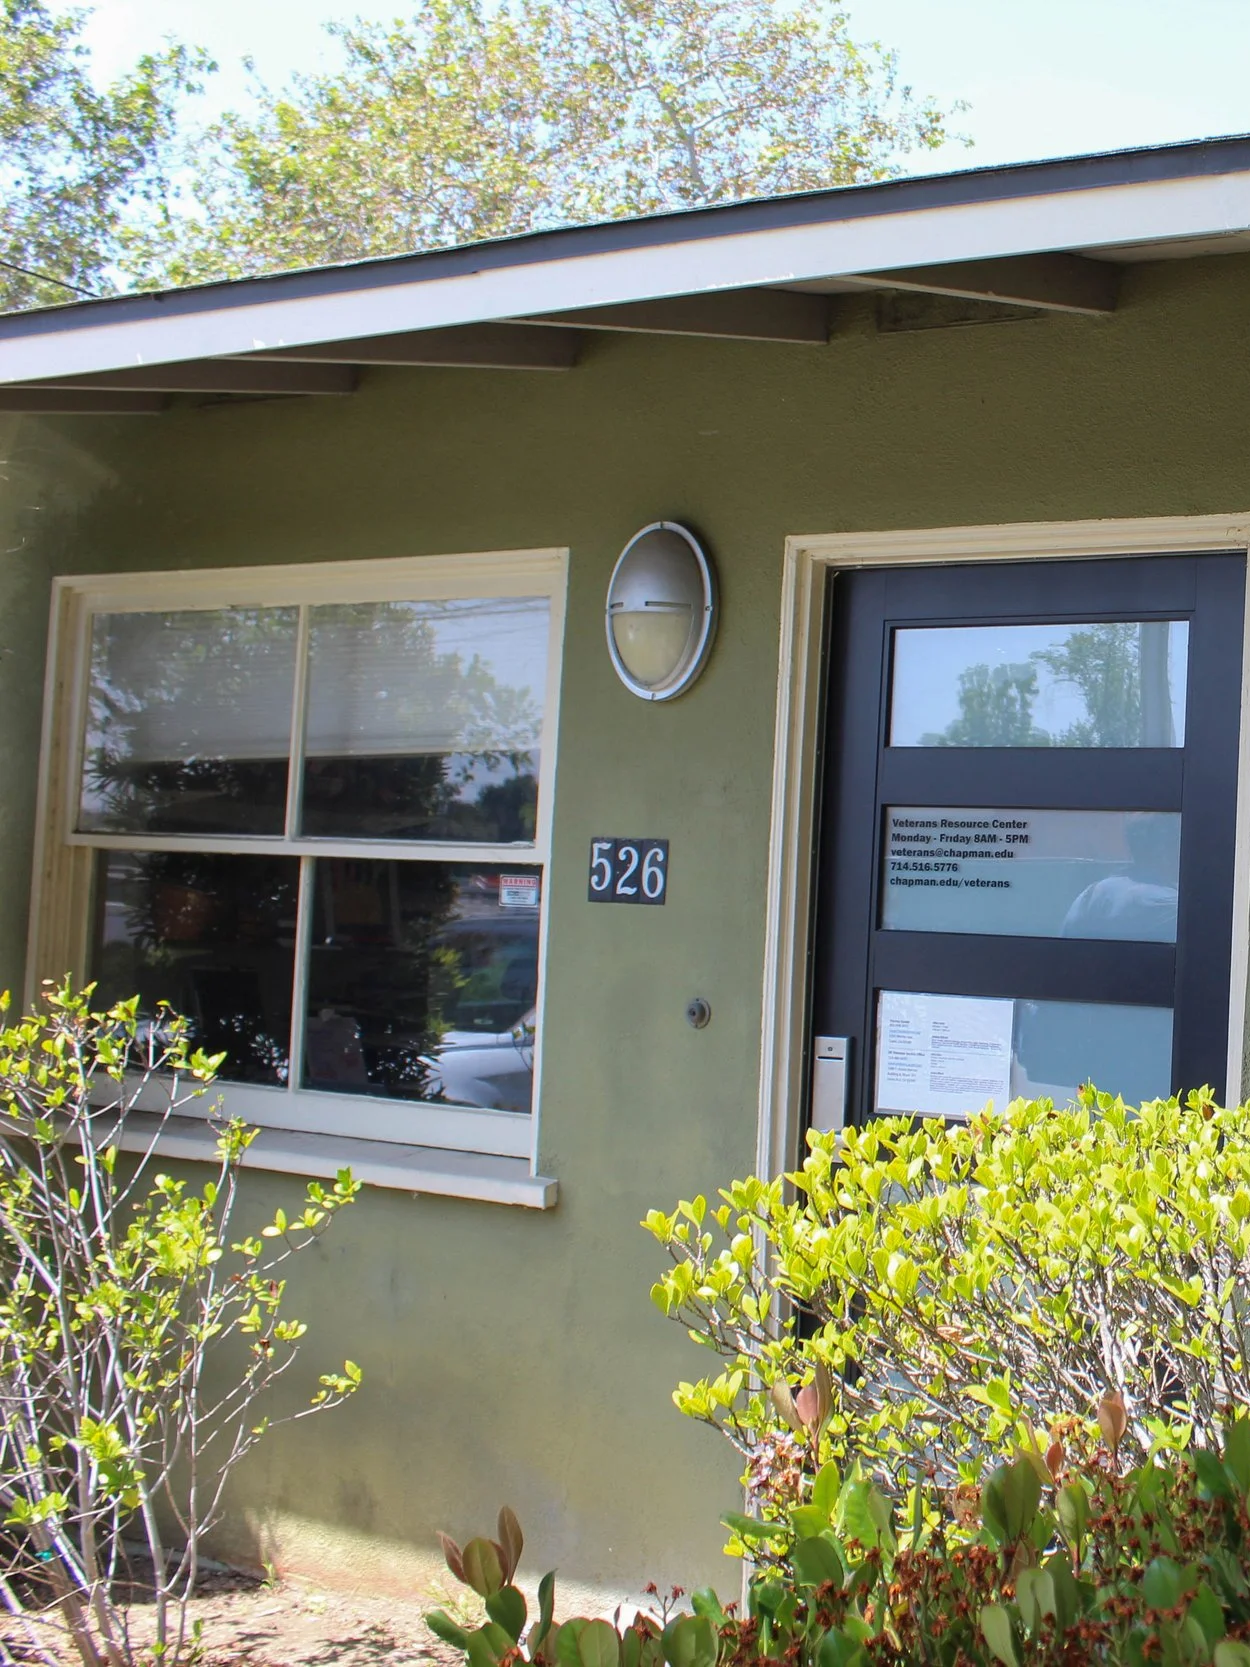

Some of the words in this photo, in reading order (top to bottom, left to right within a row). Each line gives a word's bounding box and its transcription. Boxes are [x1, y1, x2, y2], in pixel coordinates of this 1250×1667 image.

[892, 818, 938, 828] Veterans
[940, 819, 989, 829] Resource
[991, 819, 1028, 829] Center
[891, 833, 931, 844] Monday
[939, 833, 971, 845] Friday
[973, 833, 997, 843] 8AM
[1005, 834, 1029, 844] 5PM
[890, 847, 1014, 859] veterans@chapman.edu
[590, 842, 664, 898] 526
[890, 861, 959, 872] 714.516.5776
[503, 878, 537, 886] WARNING
[889, 876, 1011, 889] chapman.edu/veterans
